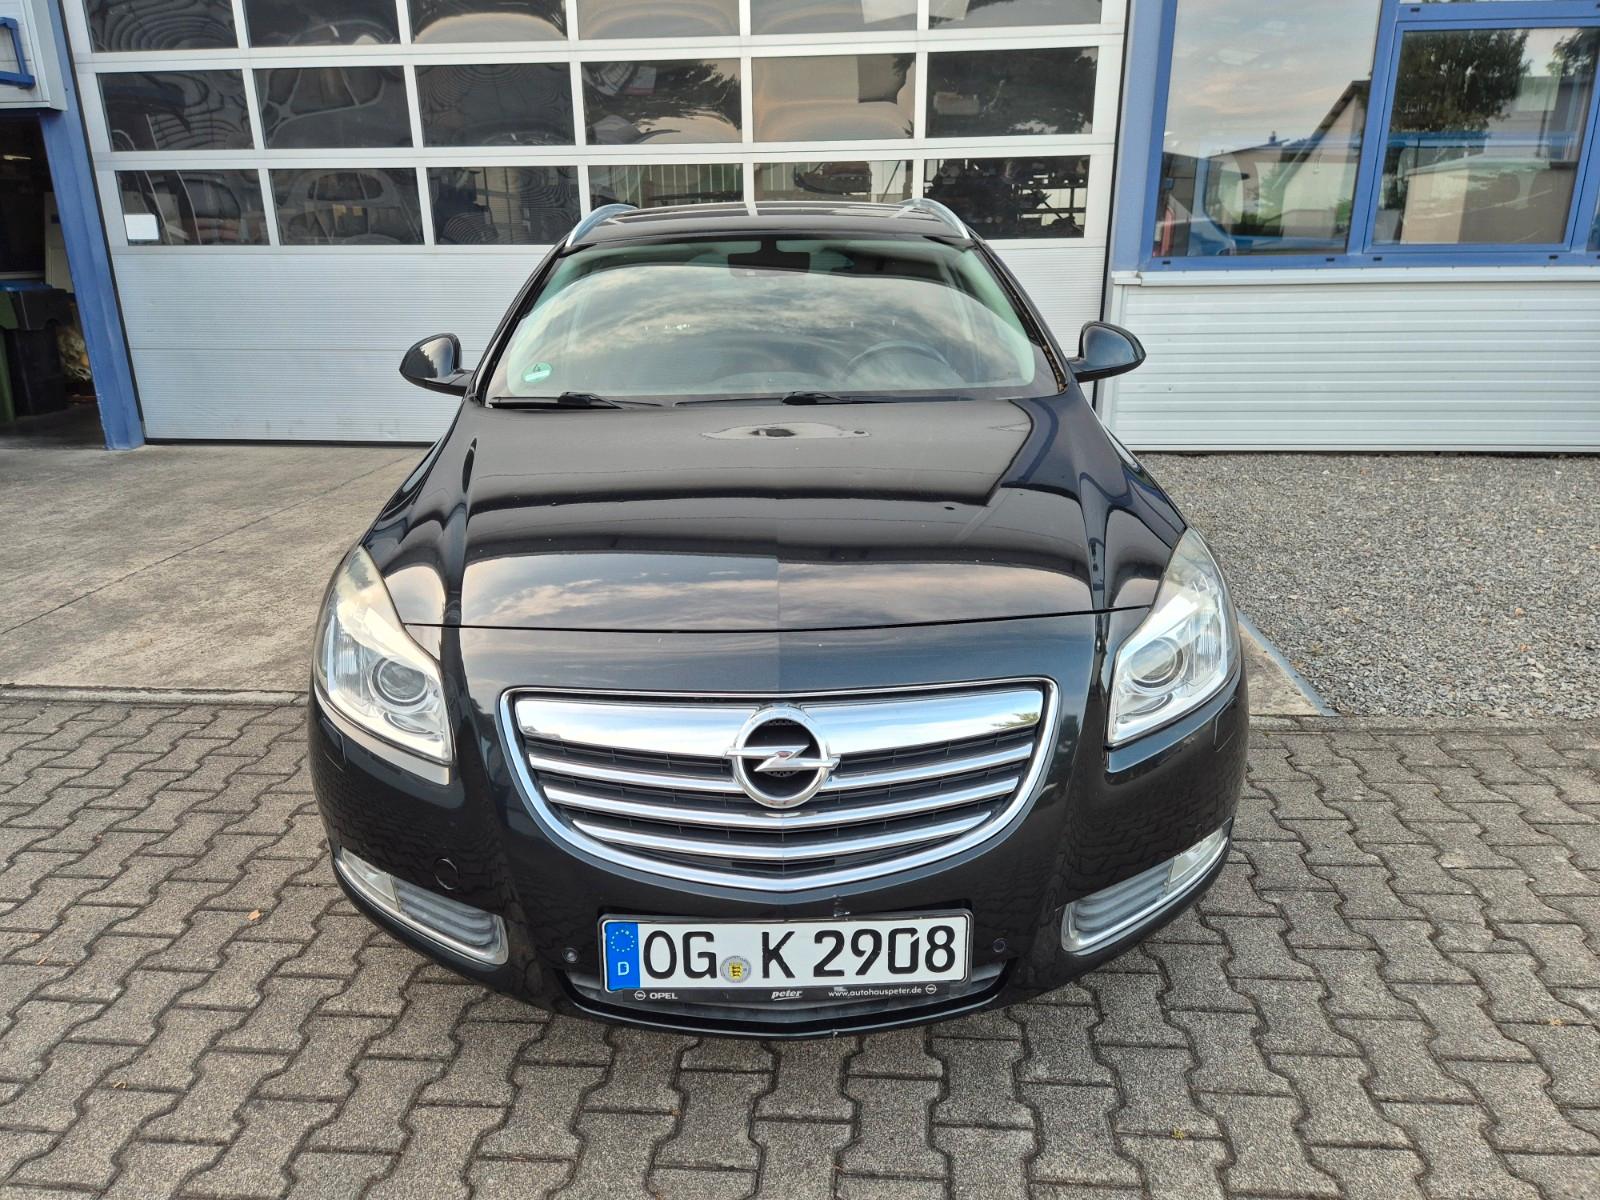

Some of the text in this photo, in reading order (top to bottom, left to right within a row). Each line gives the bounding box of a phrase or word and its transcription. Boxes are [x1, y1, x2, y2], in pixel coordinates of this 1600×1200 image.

[643, 930, 717, 980] OG
[762, 931, 796, 979] K
[813, 925, 956, 978] 2908
[617, 961, 630, 976] D
[649, 992, 678, 1000] OPEL
[771, 989, 803, 1000] peter
[828, 985, 922, 998] www.autohauspeter.de
